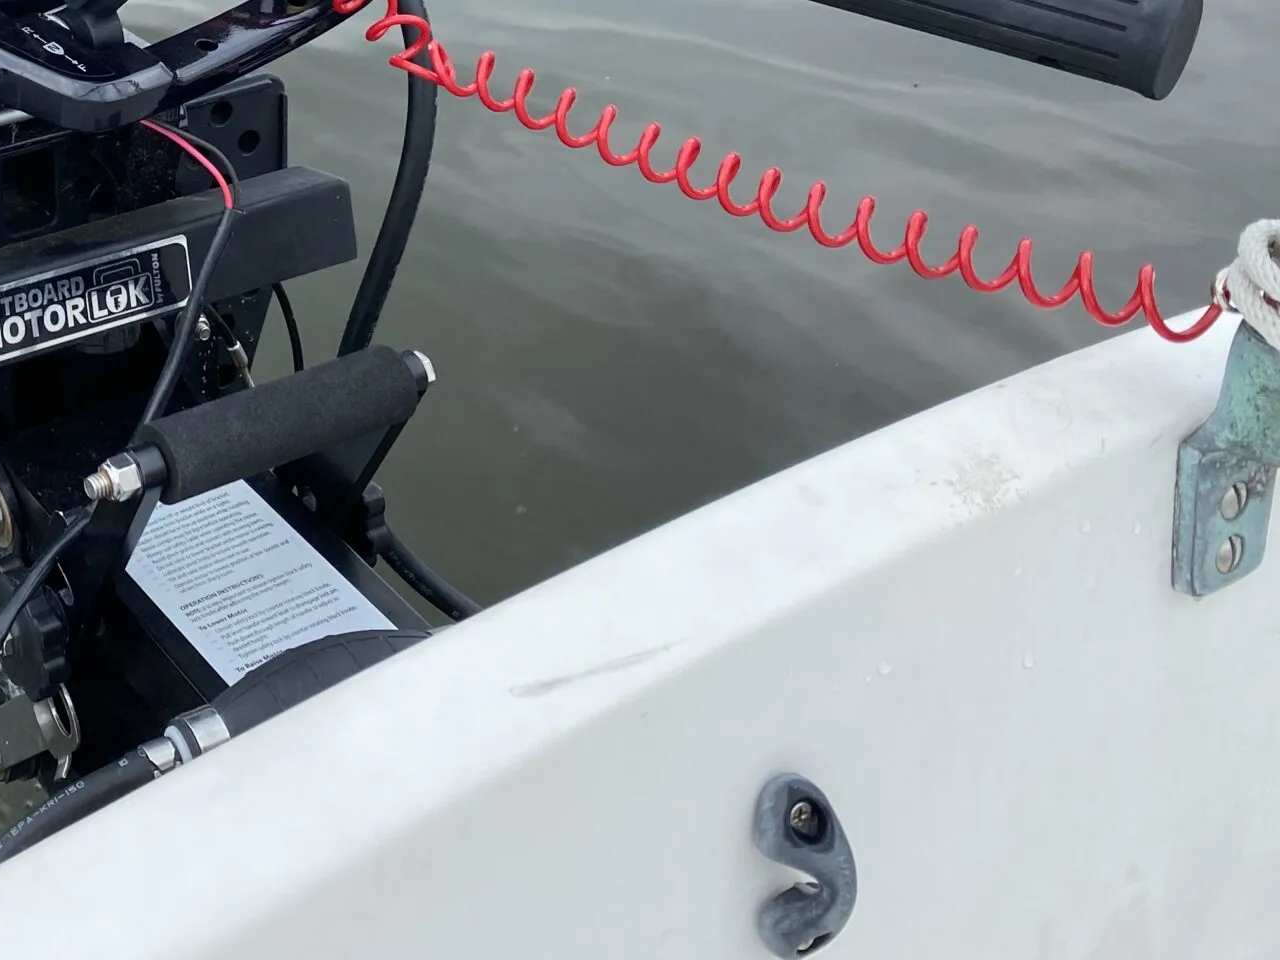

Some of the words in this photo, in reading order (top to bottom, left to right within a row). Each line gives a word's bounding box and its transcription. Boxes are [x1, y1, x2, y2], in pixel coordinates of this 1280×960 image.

[22, 26, 35, 34] R
[77, 63, 87, 73] F
[151, 253, 162, 293] FULTON
[180, 593, 218, 610] OPERATION
[217, 574, 265, 595] INSTRUCTIONS
[207, 616, 228, 627] Lower
[227, 608, 248, 619] Motor
[246, 658, 264, 668] Raise
